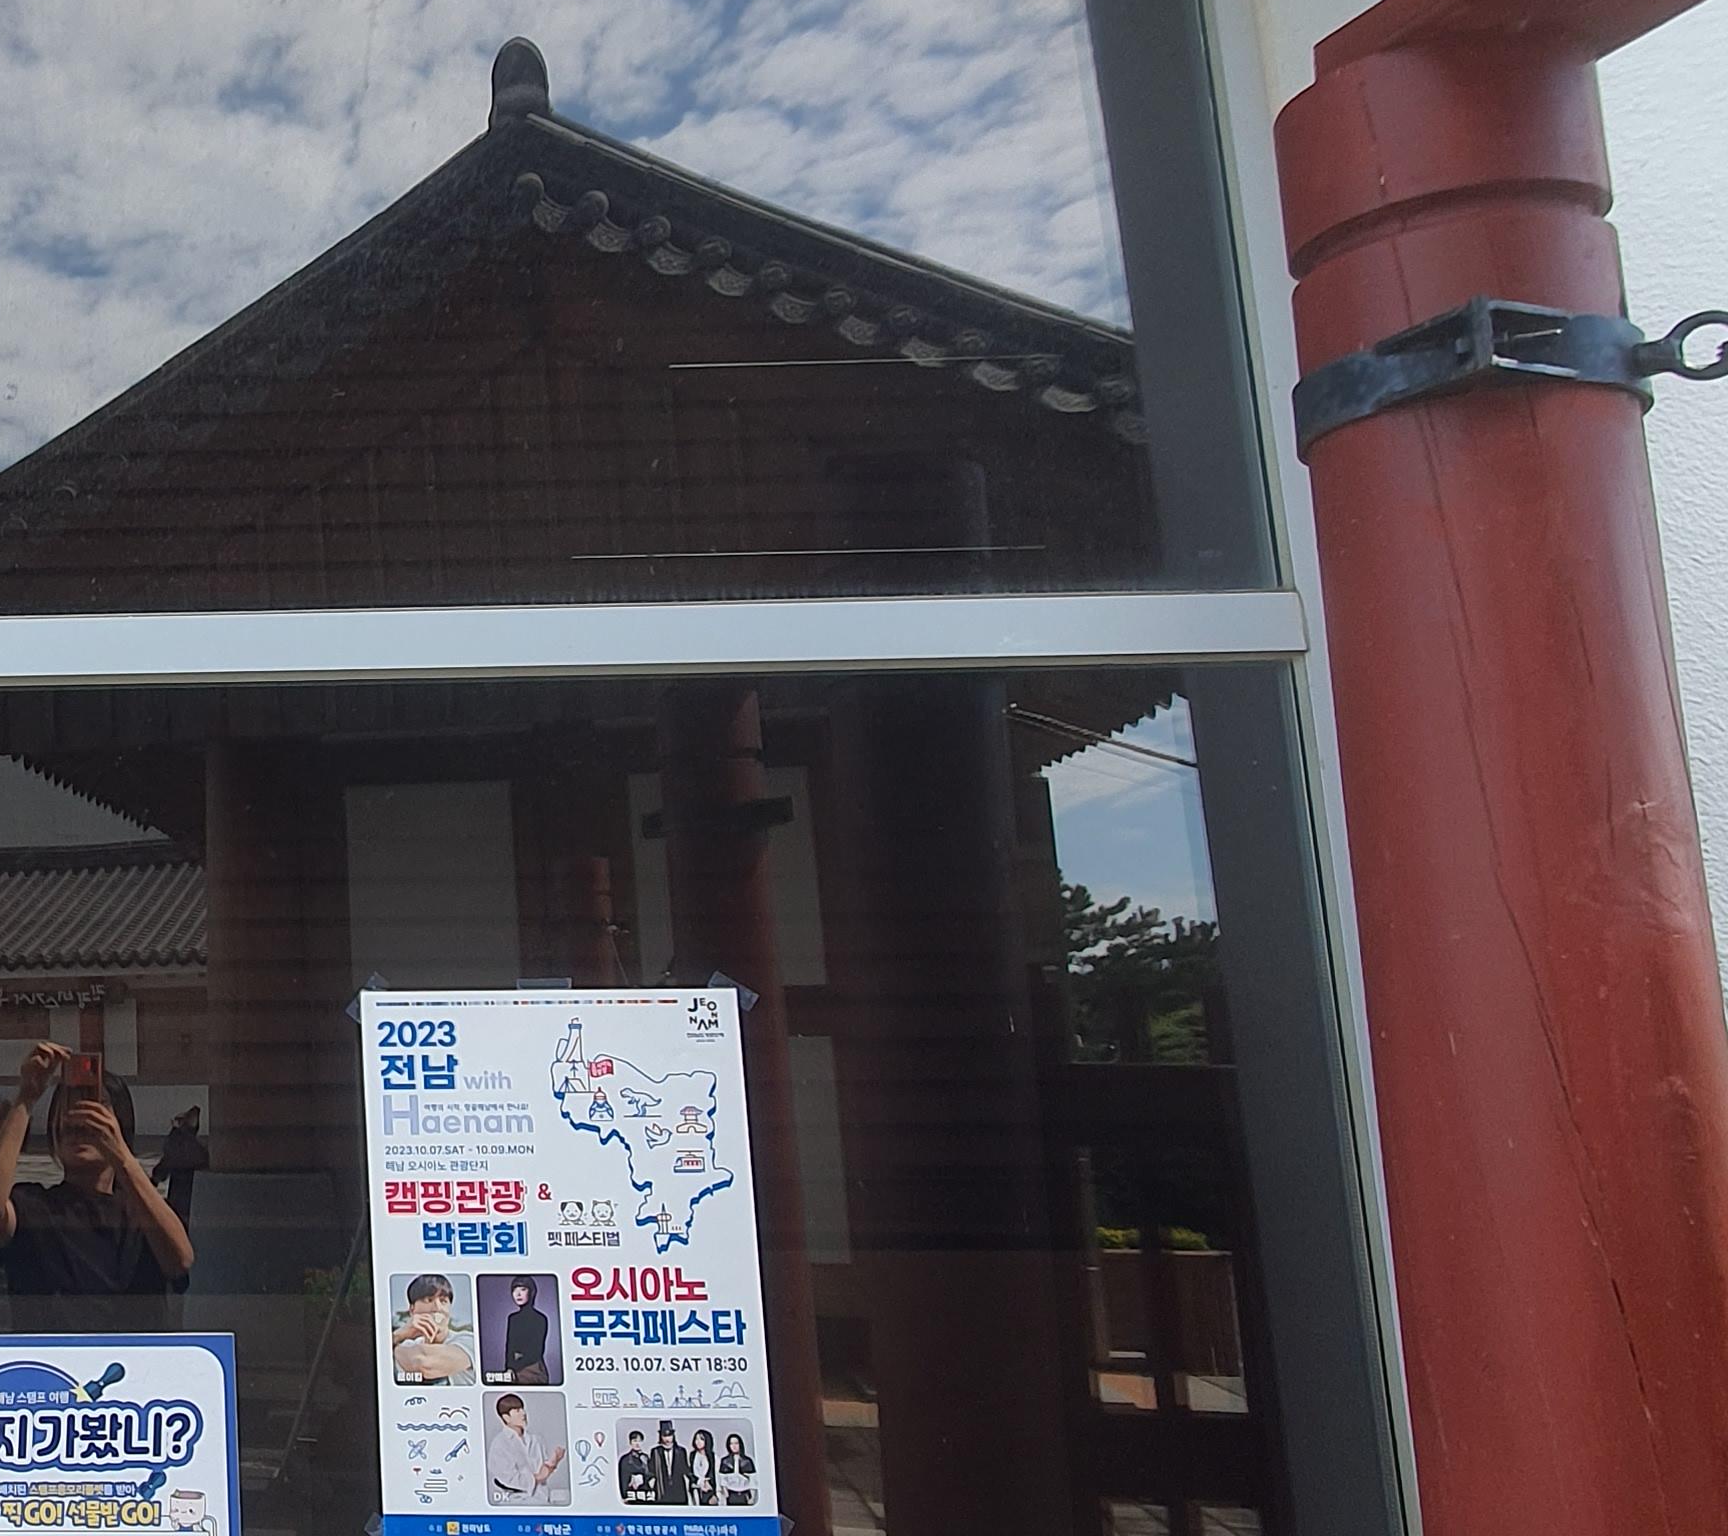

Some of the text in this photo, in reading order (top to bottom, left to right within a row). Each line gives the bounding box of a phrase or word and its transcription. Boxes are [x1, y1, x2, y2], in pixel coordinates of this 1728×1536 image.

[377, 1020, 457, 1047] 2023
[380, 1054, 512, 1090] 전남 with
[382, 1094, 535, 1136] Haenam
[385, 1145, 465, 1156] 2023.10.07.SAT
[476, 1144, 535, 1156] 10.09.MON
[450, 1160, 489, 1172] 관광단지
[385, 1180, 552, 1215] 캠핑관광 &
[423, 1221, 529, 1256] 박람회
[570, 1266, 709, 1302] 오시아노
[573, 1309, 747, 1346] 뮤직페스타
[575, 1357, 748, 1372] 2023. 10.07. SAT 18:30
